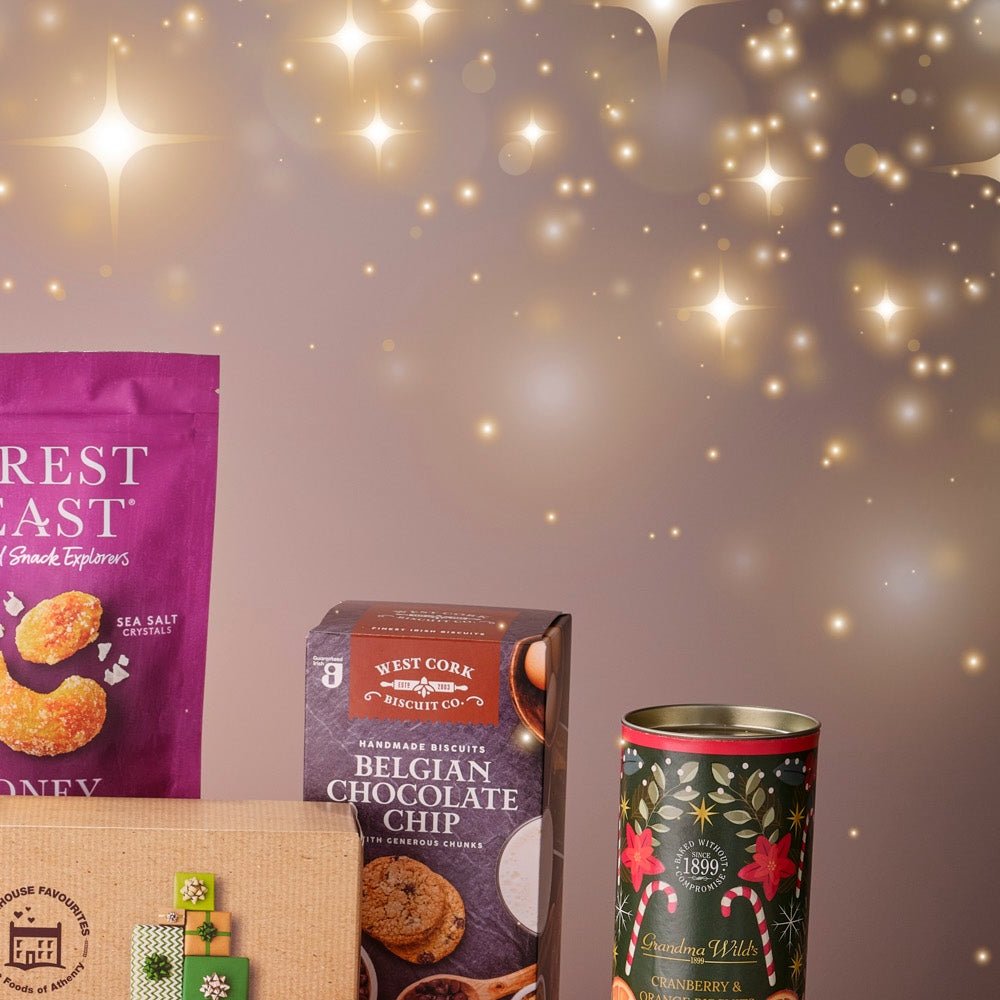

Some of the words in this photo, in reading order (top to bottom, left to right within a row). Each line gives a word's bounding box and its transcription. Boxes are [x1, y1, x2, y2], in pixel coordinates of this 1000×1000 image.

[9, 545, 61, 566] Snack
[62, 546, 130, 571] Explorers
[116, 616, 141, 627] SEA
[147, 614, 178, 626] SALT
[122, 626, 172, 637] CRYSTALS
[375, 657, 422, 676] WEST
[425, 657, 476, 680] CORK
[384, 694, 438, 710] BISCUIT
[442, 698, 464, 709] CO.
[359, 740, 426, 751] HANDMADE
[431, 743, 486, 754] BISCUITS
[354, 754, 492, 783] BELGIAN
[326, 779, 519, 811] CHOCOLATE
[383, 809, 461, 834] CHIP
[386, 837, 439, 847] GENEROUS
[443, 840, 483, 849] CHUNKS
[674, 840, 695, 864] BAKED
[698, 839, 729, 867] WITHOUT
[683, 857, 719, 876] 1899
[691, 851, 711, 859] SINCE
[675, 870, 726, 893] COMPROMISE
[38, 886, 90, 936] FAVOURITES
[640, 932, 706, 957] Grandma
[708, 939, 759, 958] Wild's
[690, 957, 705, 965] 1899
[2, 977, 34, 994] Foods
[37, 985, 48, 994] of
[51, 962, 85, 992] Athenry
[651, 975, 731, 992] CRANBERRY
[732, 981, 742, 993] &
